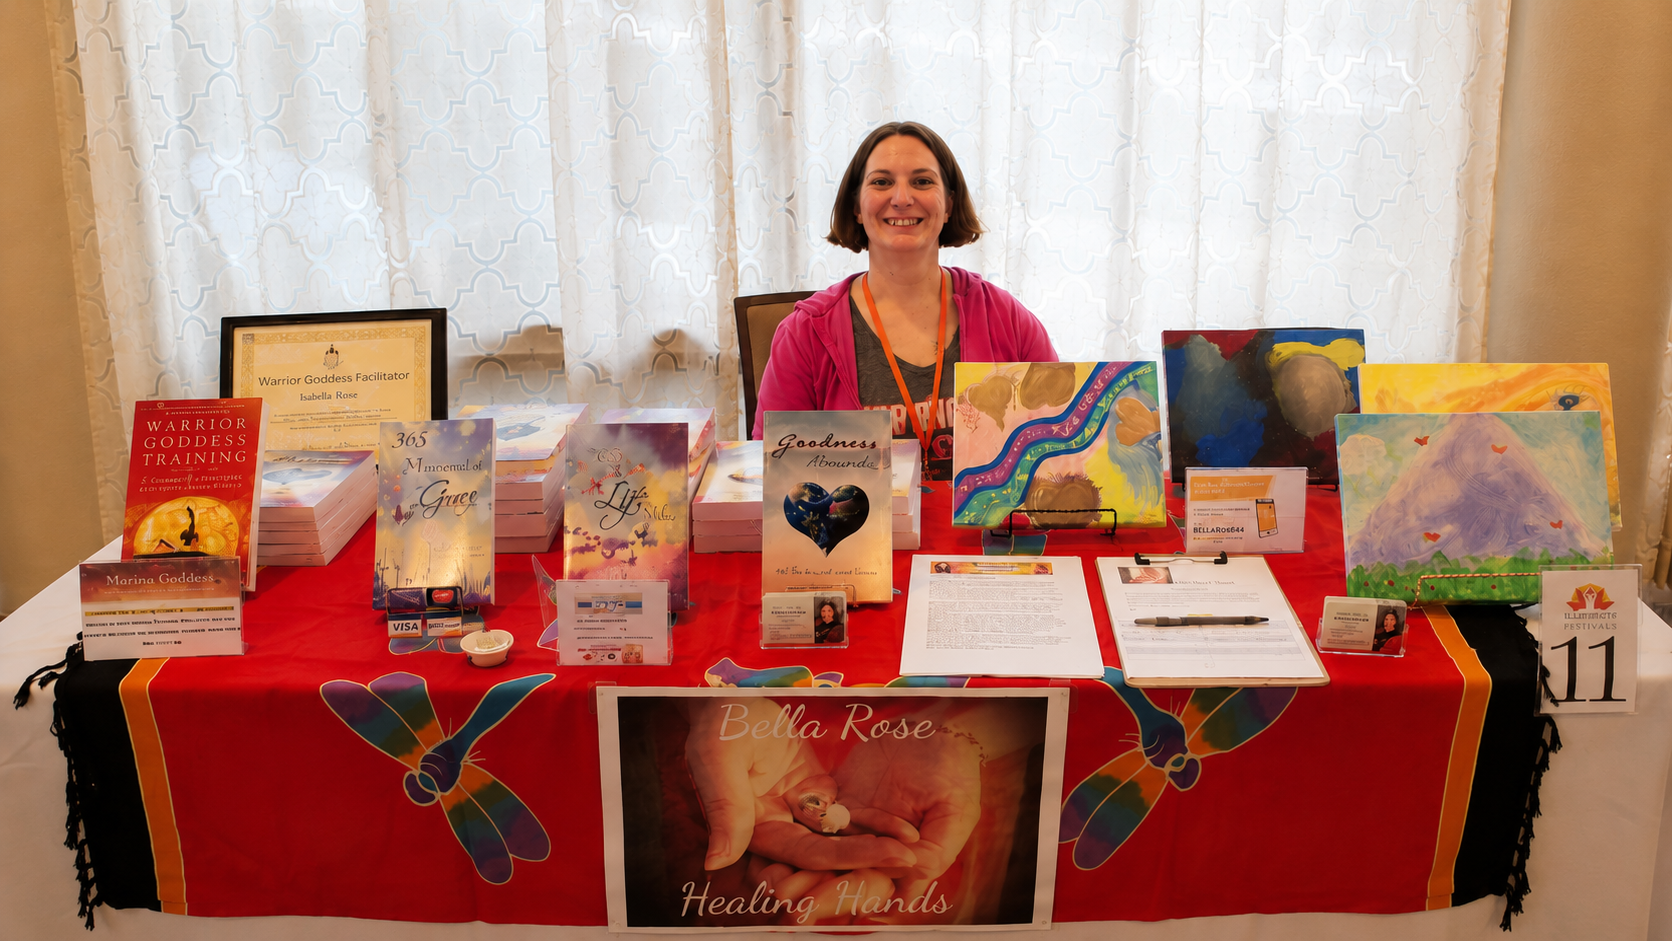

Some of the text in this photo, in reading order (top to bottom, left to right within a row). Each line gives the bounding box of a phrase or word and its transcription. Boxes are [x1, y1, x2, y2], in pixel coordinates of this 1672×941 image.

[258, 370, 410, 387] Warrior Goddess Facilitator
[299, 391, 358, 402] Isabella Rose
[146, 417, 247, 432] WARRIOR
[143, 433, 247, 449] GODDESS
[391, 430, 428, 449] 365
[771, 433, 878, 460] Goodness
[142, 450, 247, 466] TRAINING
[106, 571, 214, 586] Marina Goddess
[393, 622, 419, 632] VISA
[1550, 635, 1627, 703] 11
[718, 703, 936, 743] Bella Rose
[681, 880, 953, 924] Healing Hands
